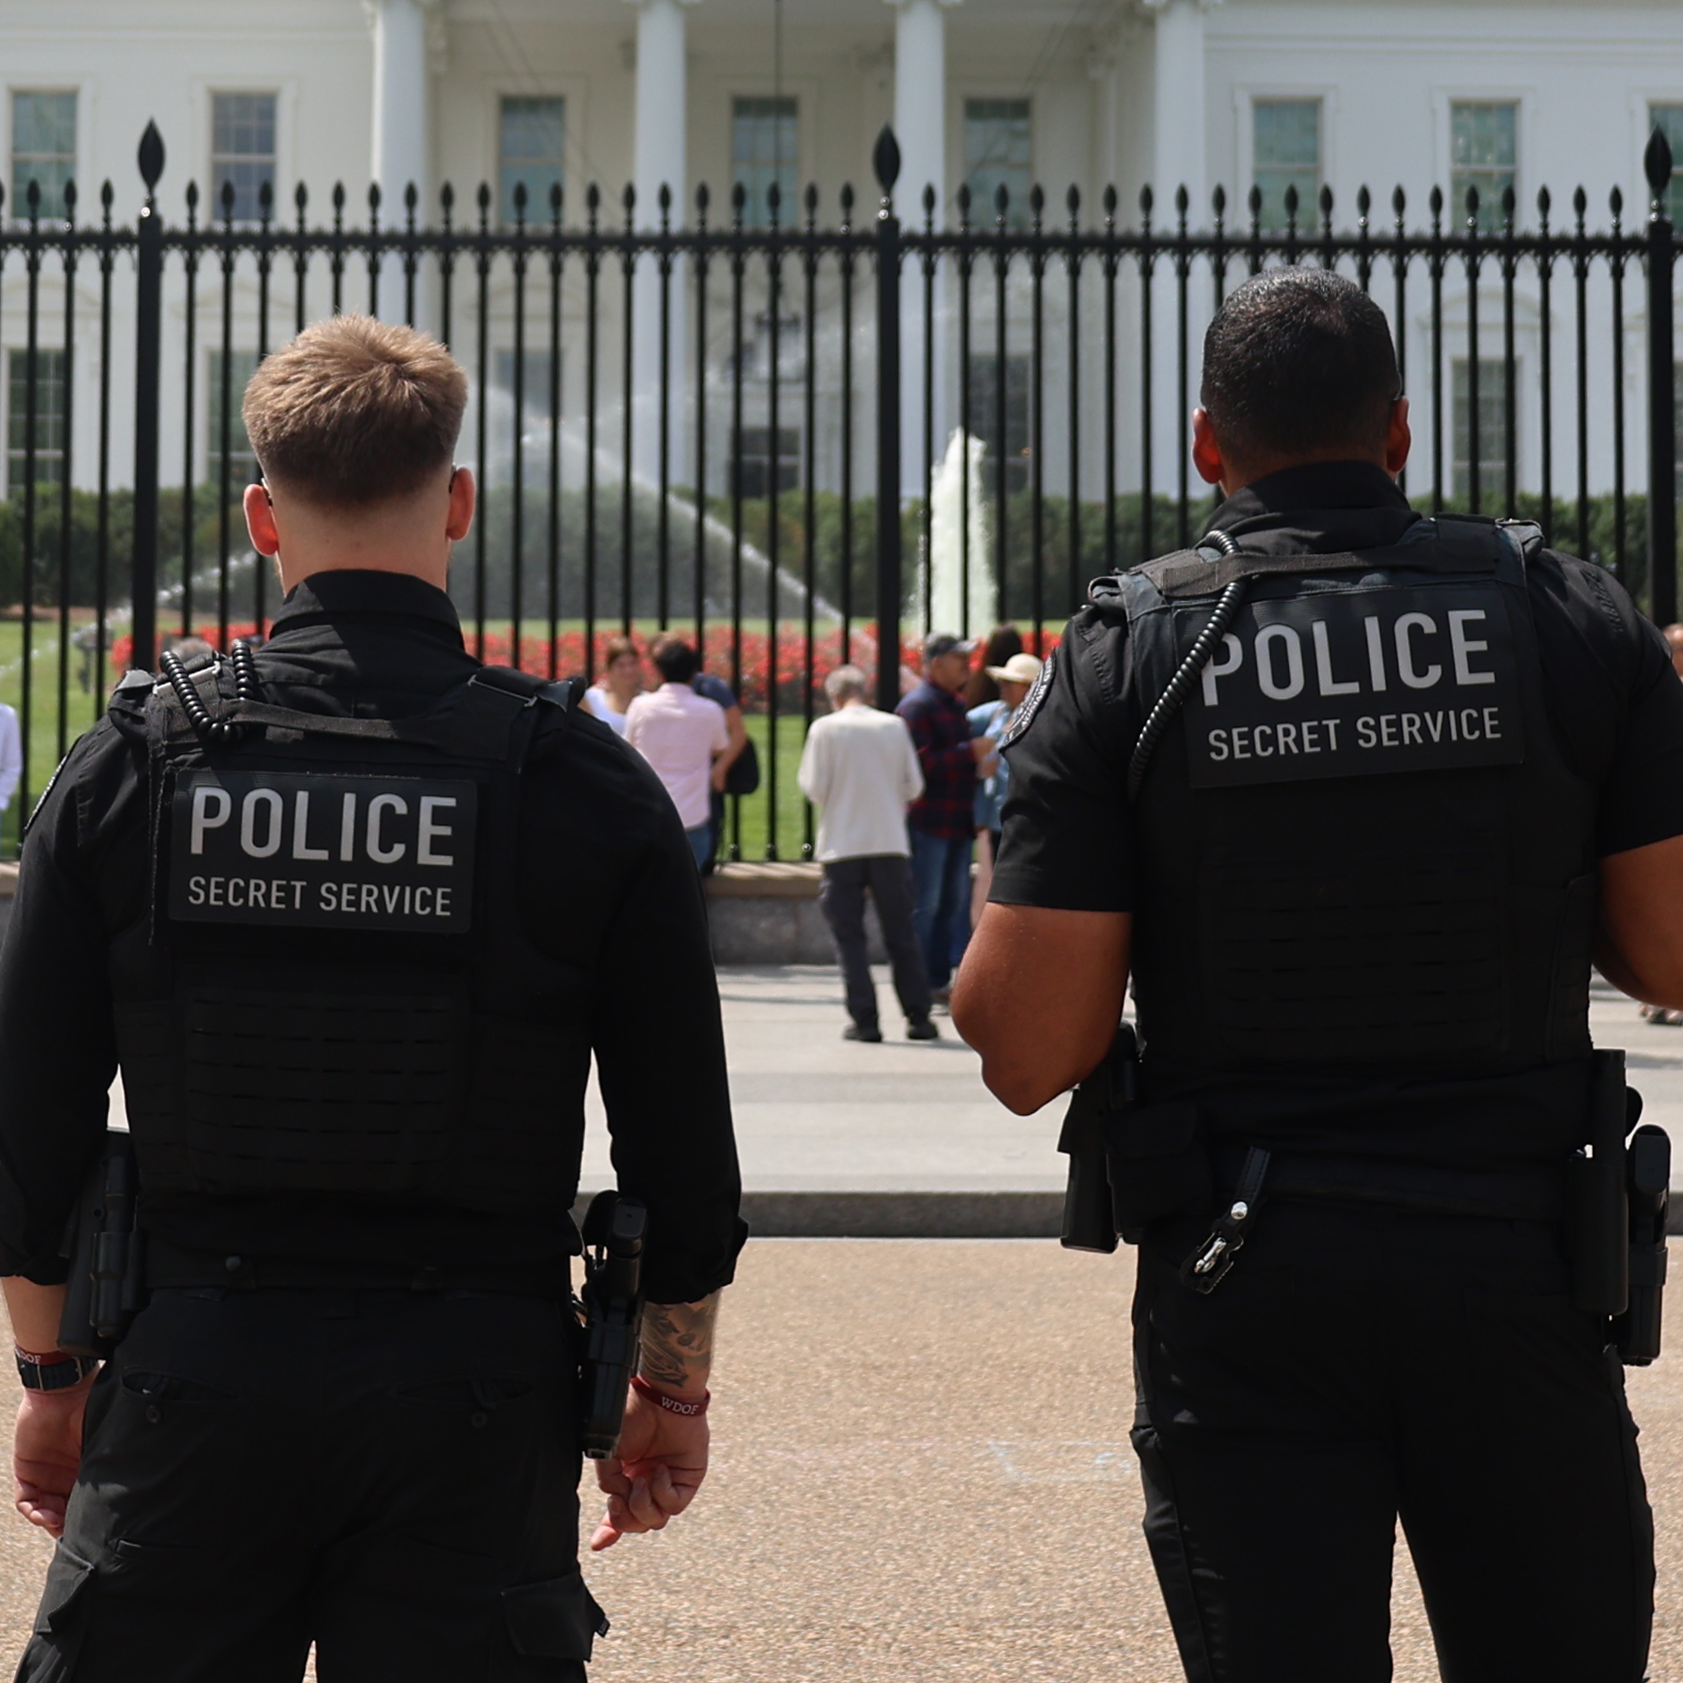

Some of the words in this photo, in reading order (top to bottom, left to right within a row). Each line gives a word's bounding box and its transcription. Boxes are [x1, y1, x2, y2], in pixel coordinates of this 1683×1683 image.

[1201, 609, 1496, 707] POLICE
[1208, 719, 1340, 761] SECRET
[1355, 707, 1502, 749] SERVICE
[190, 786, 458, 866] POLICE
[188, 875, 307, 909] SECRET
[319, 882, 453, 916] SERVICE
[661, 1396, 699, 1415] WDOF
